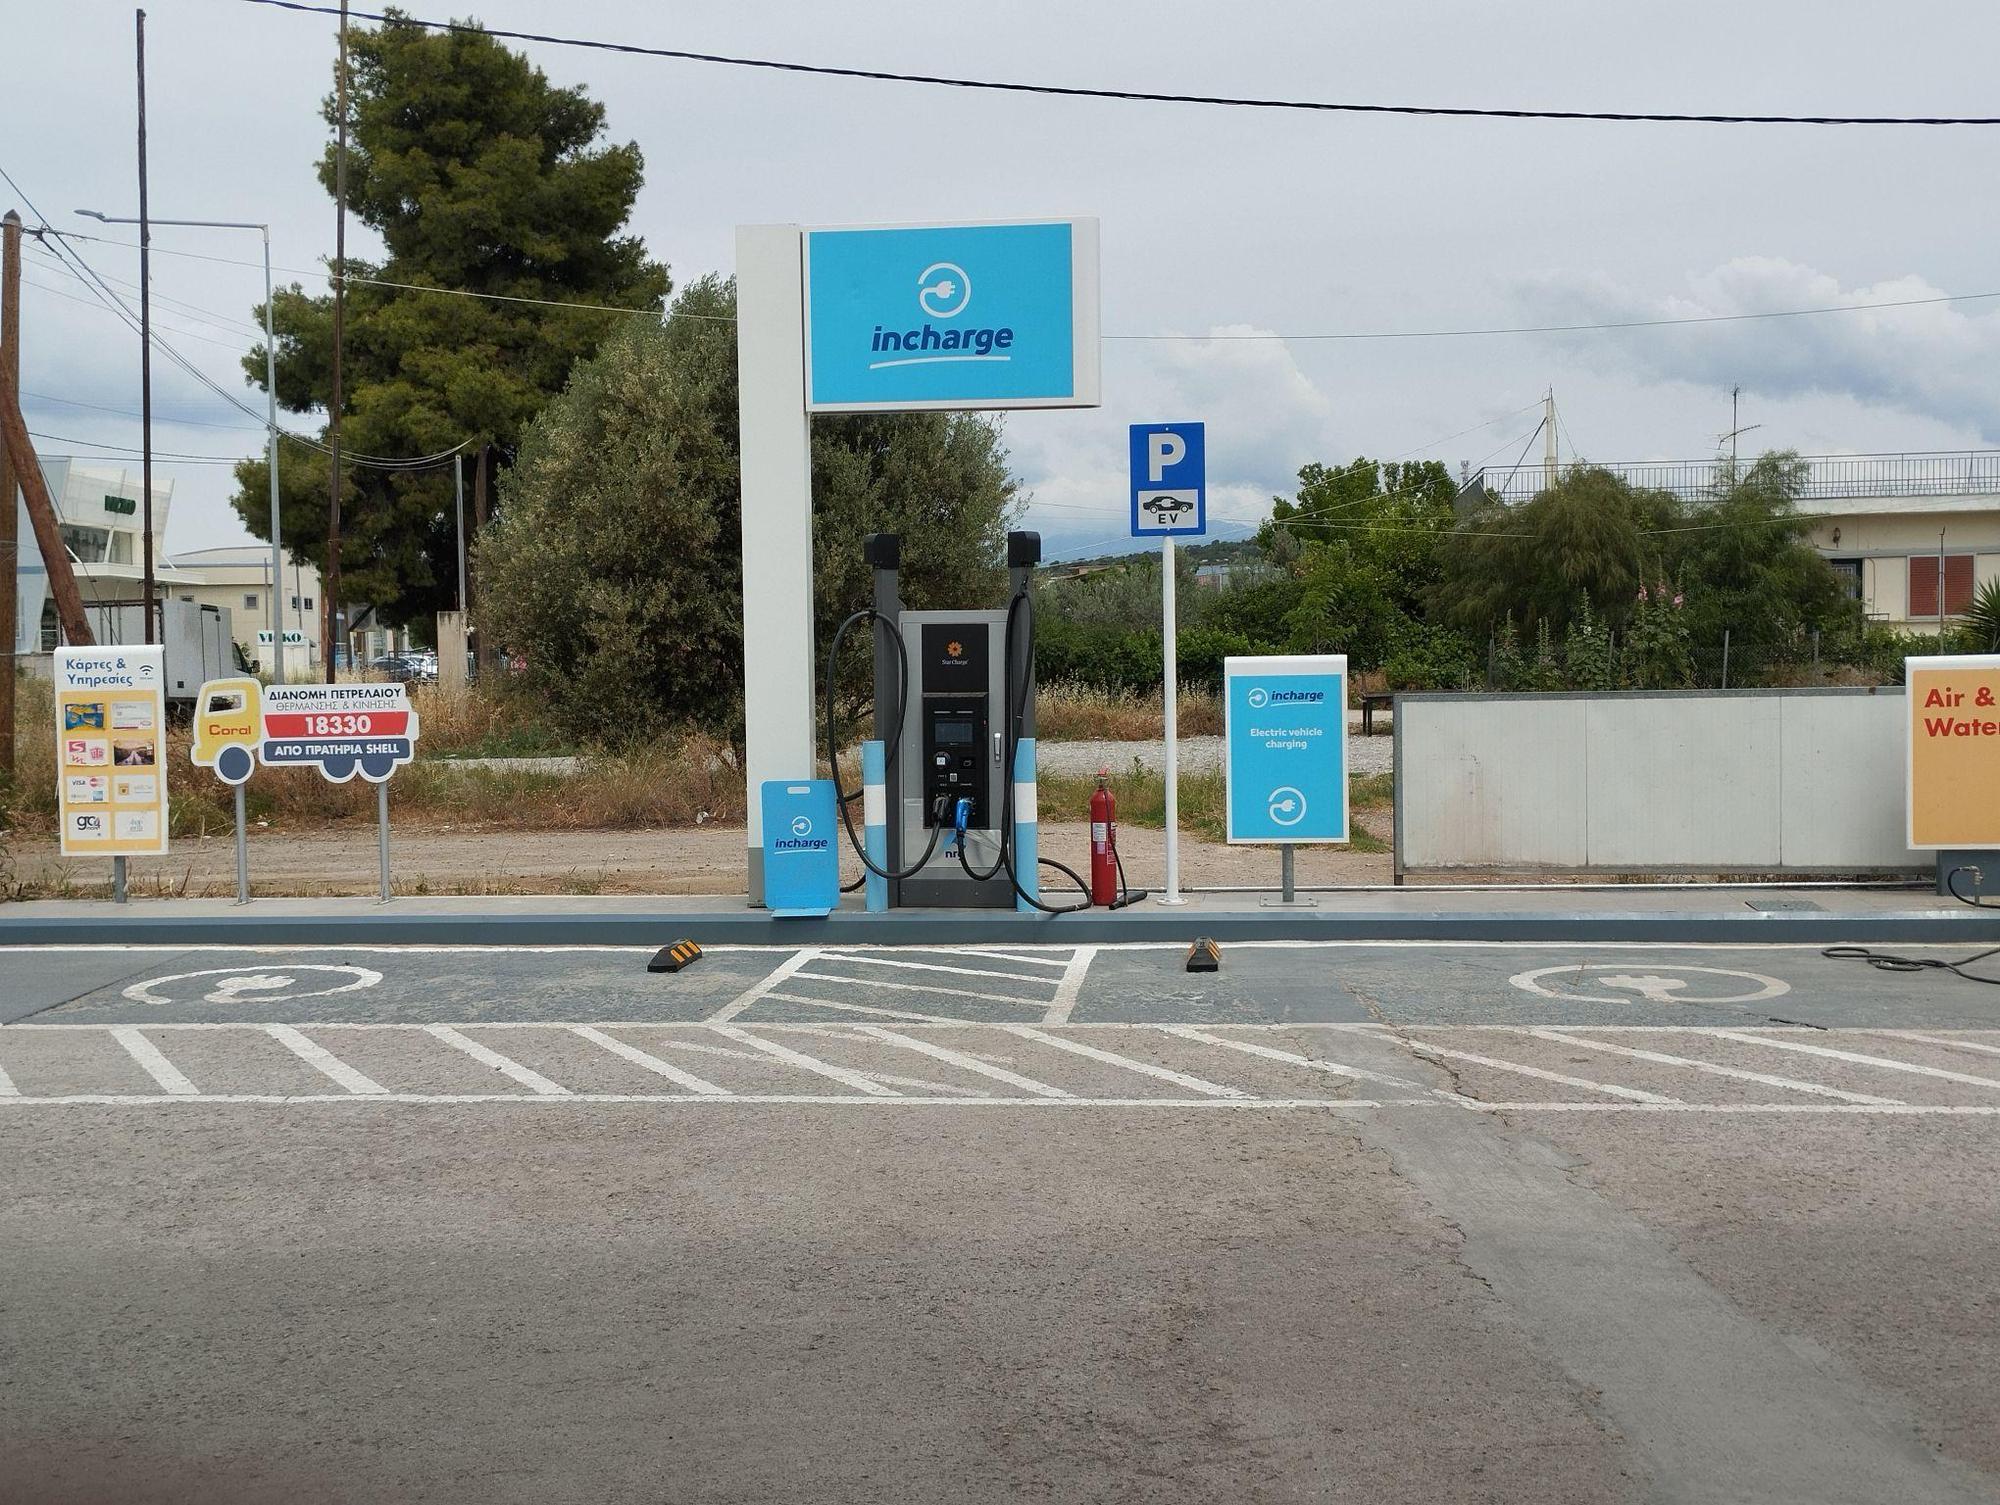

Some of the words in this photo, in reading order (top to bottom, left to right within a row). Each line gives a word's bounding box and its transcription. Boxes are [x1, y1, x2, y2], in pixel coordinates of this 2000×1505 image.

[871, 324, 1014, 355] incharge
[1148, 432, 1186, 481] P
[1158, 513, 1178, 524] EV
[66, 659, 113, 673] Κάρτες
[116, 658, 127, 669] &
[67, 673, 133, 687] Υπηρεσίες
[269, 689, 327, 701] ΔΙΑΝΟΜΗ
[330, 688, 401, 700] ΠΕΤΡΕΛΑΙΟΥ
[1271, 691, 1324, 702] incharge
[1924, 686, 1965, 708] Air
[1975, 686, 1996, 707] &
[275, 701, 338, 711] ΘΕΡΜΑΝΣΗΣ
[342, 700, 350, 710] &
[352, 700, 397, 709] ΚΙΝΗΣΗΣ
[208, 724, 252, 736] Coral
[304, 715, 372, 735] 18330
[1923, 717, 2000, 737] Wate
[1250, 728, 1287, 737] Electric
[1289, 728, 1323, 737] vehicle
[274, 745, 303, 756] ΑΠΟ
[305, 744, 363, 755] ΠΡΑΤΗΡΙΑ
[366, 743, 400, 754] SHELL
[1265, 740, 1308, 750] charging
[775, 838, 828, 849] incharge
